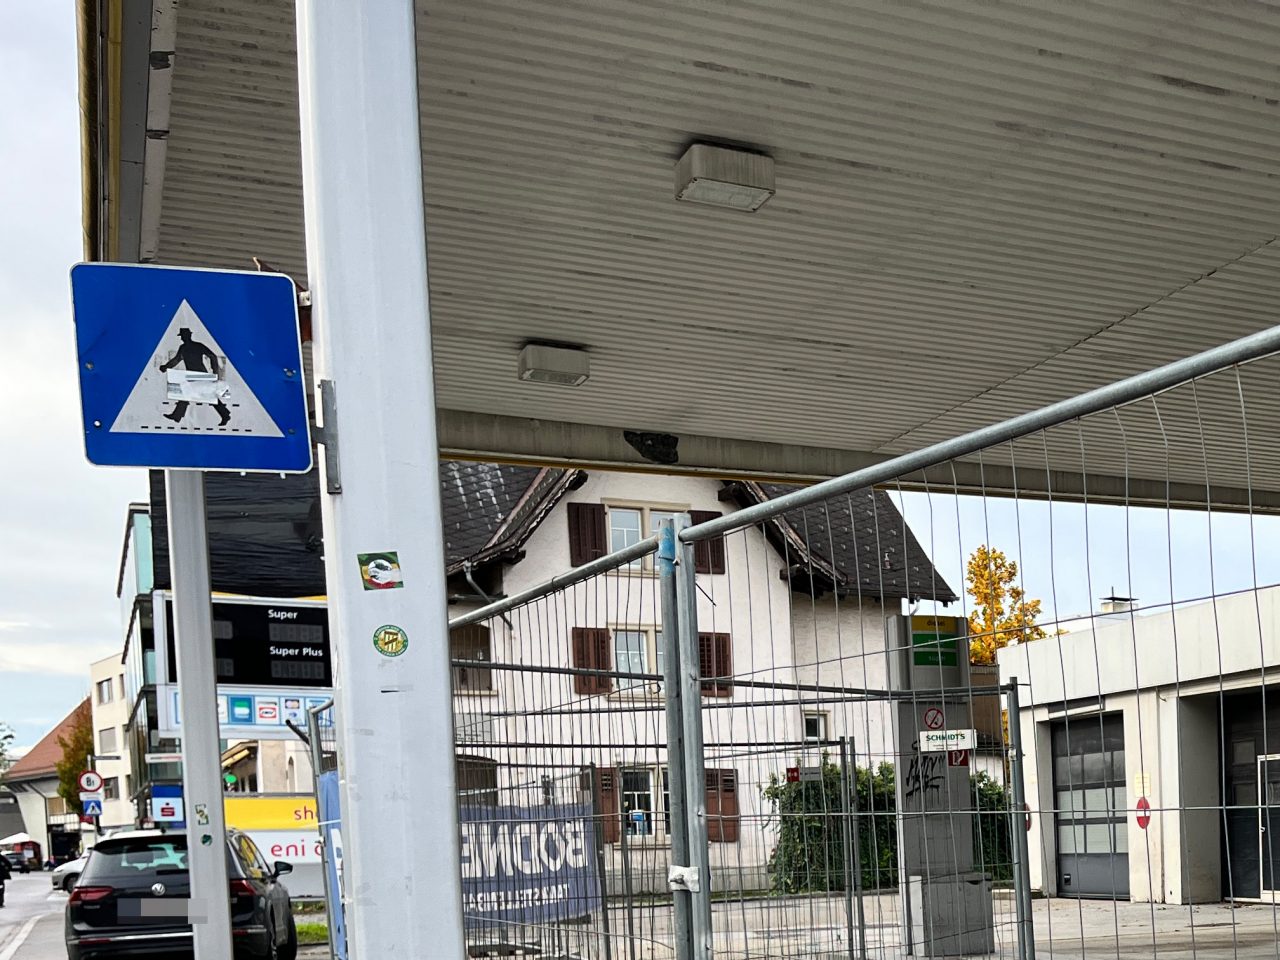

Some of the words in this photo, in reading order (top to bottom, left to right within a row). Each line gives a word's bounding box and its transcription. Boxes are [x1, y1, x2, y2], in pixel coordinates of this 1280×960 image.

[268, 609, 298, 620] Super
[269, 646, 299, 657] Super
[302, 647, 323, 657] Plus
[271, 839, 305, 857] eni
